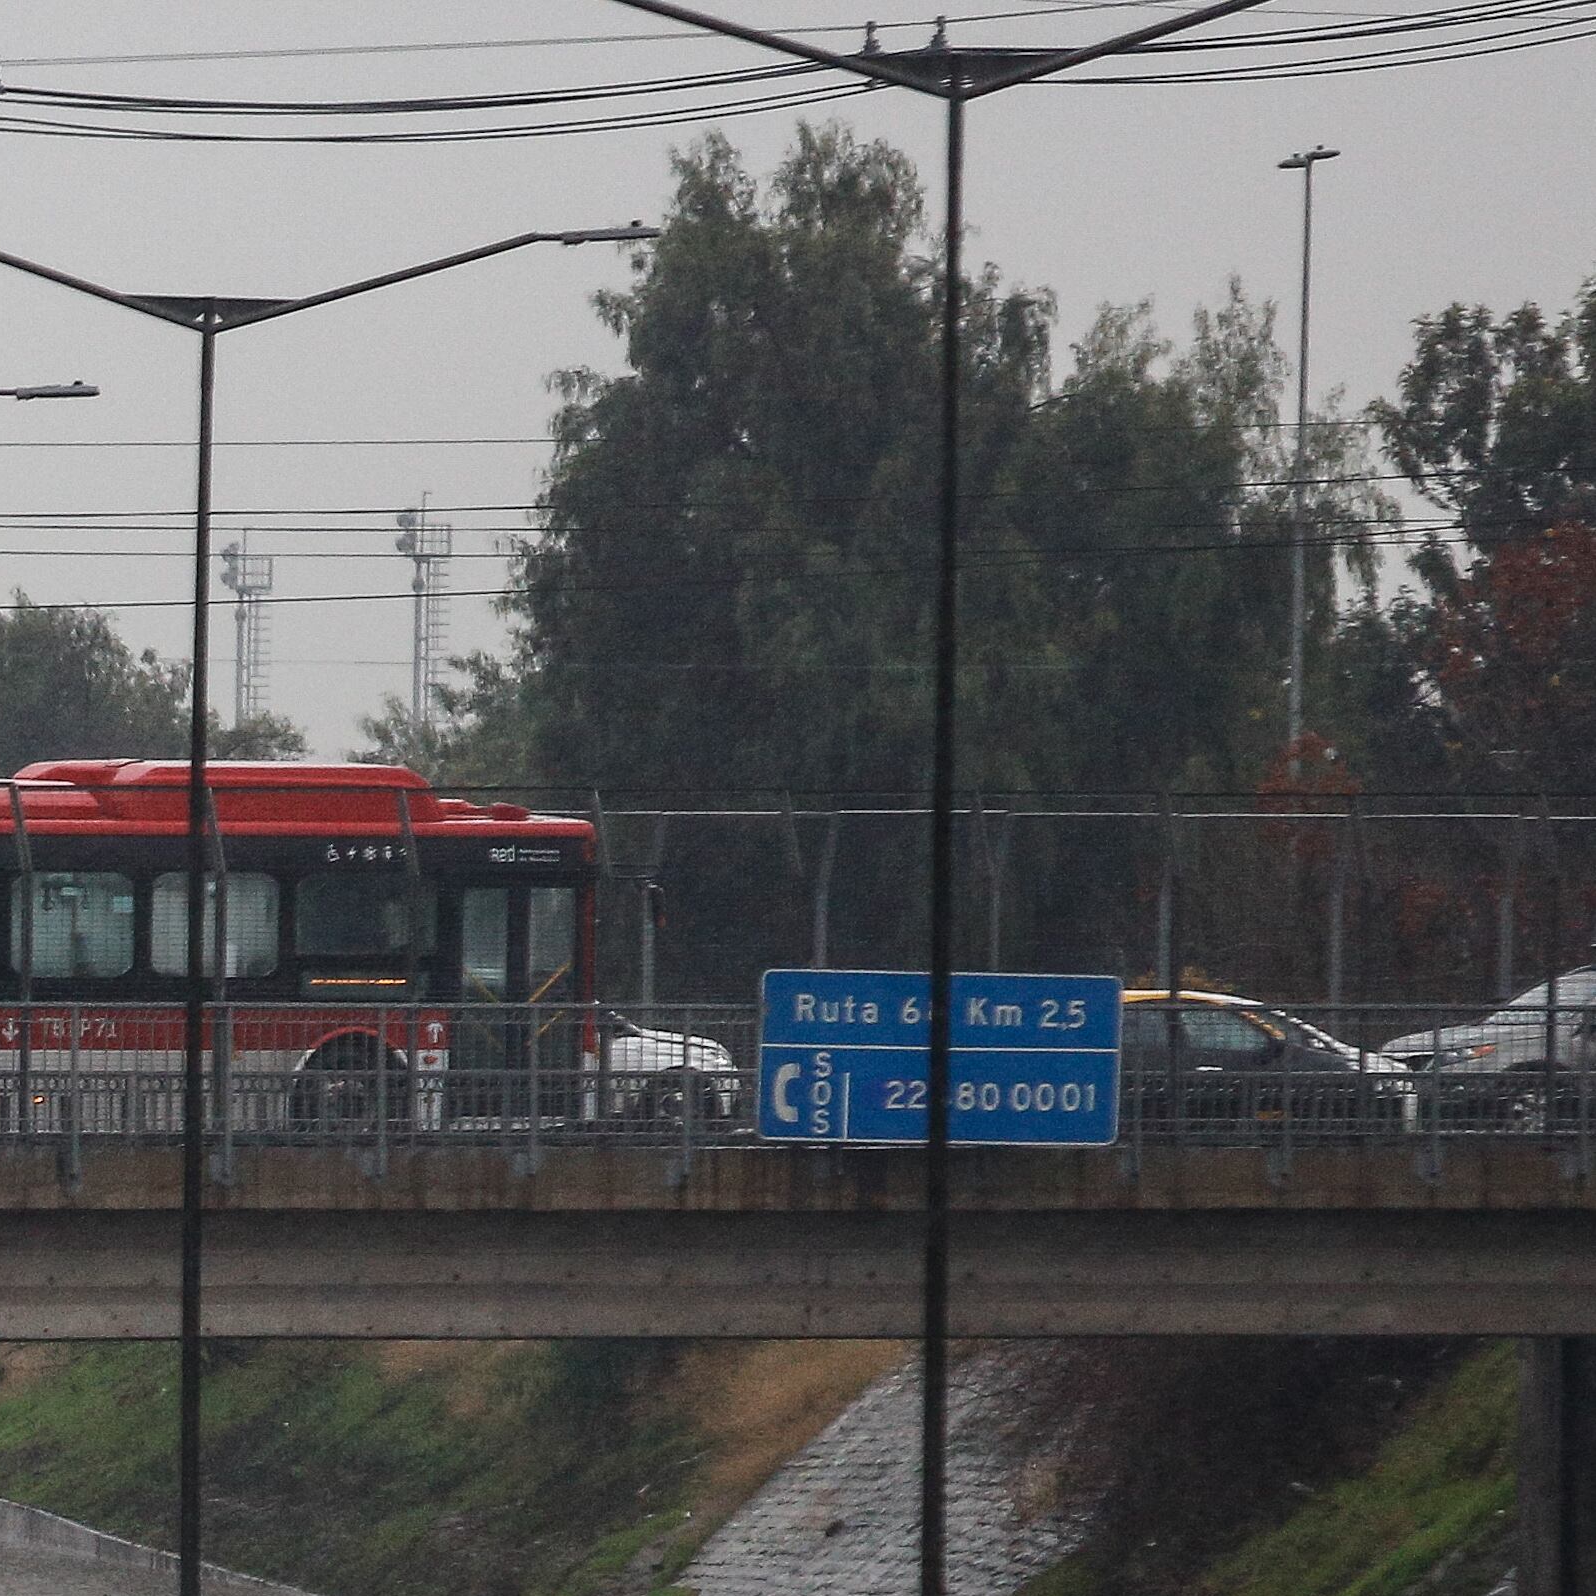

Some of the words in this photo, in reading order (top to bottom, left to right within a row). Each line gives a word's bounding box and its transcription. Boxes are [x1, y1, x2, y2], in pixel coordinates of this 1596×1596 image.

[793, 993, 880, 1025] Ruta
[902, 996, 934, 1025] 6
[966, 996, 1023, 1028] Km
